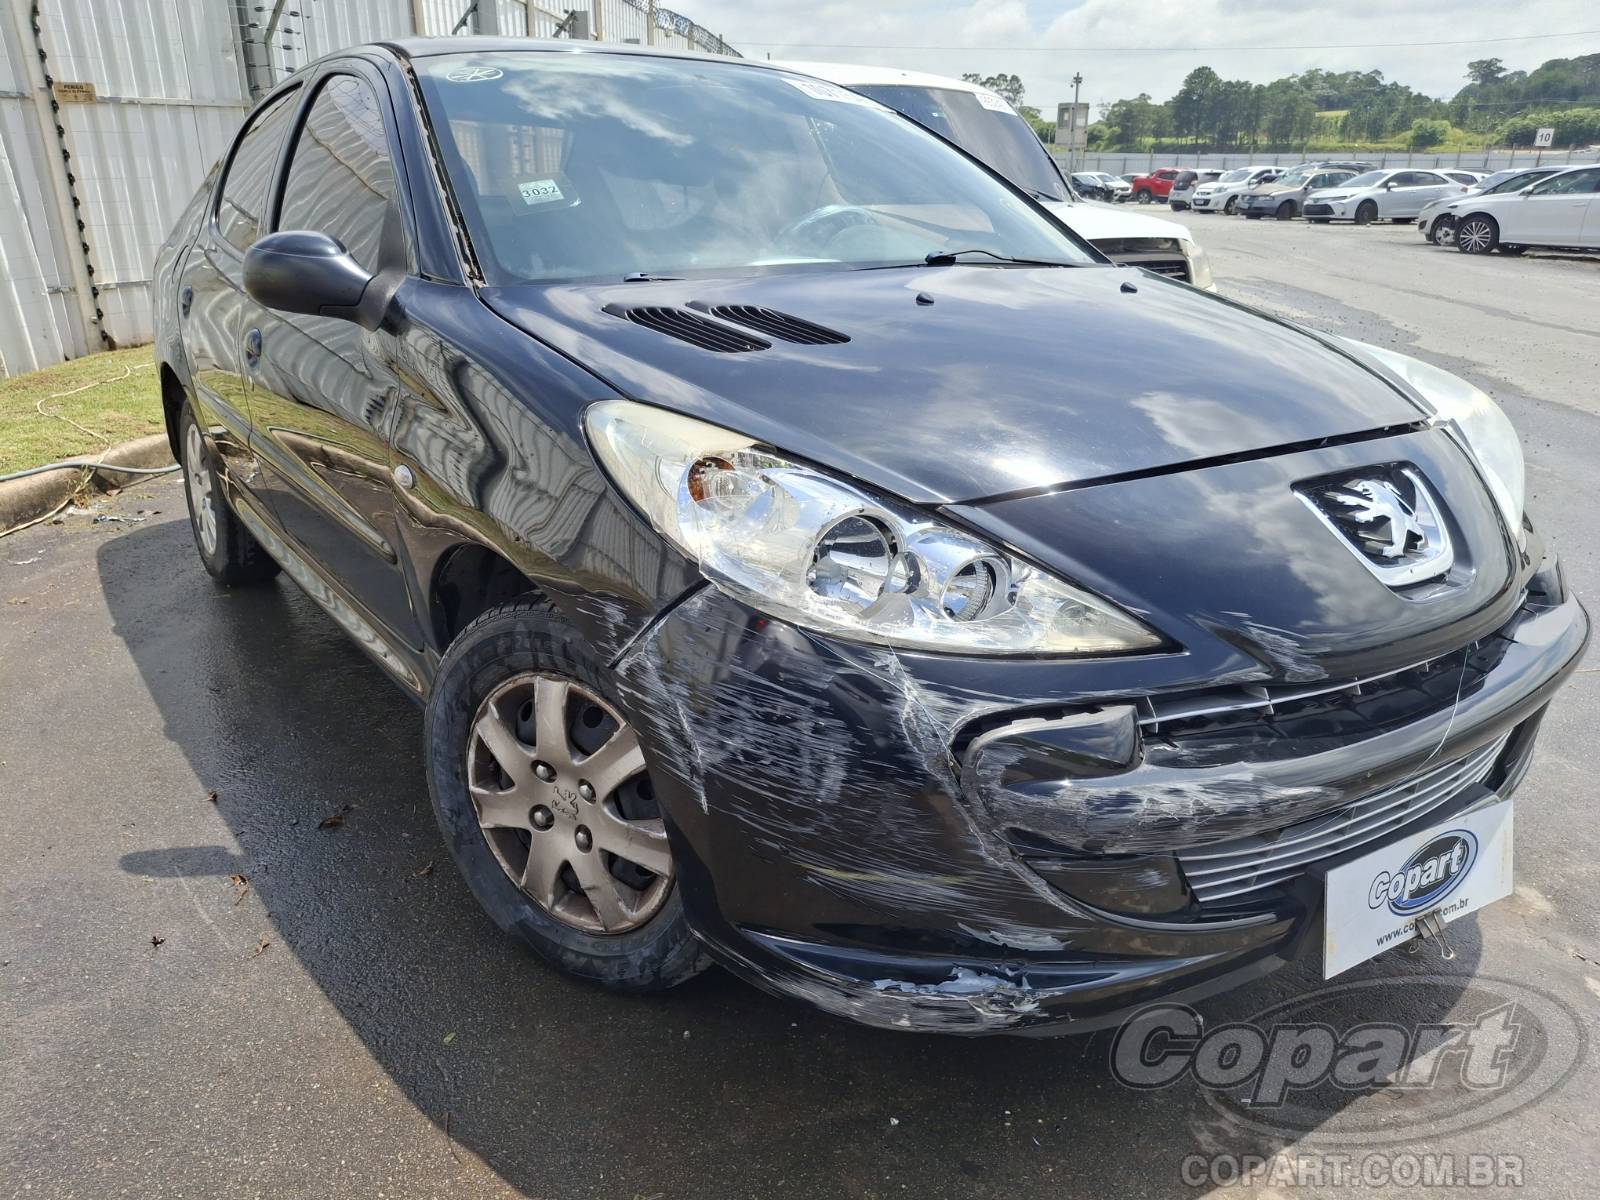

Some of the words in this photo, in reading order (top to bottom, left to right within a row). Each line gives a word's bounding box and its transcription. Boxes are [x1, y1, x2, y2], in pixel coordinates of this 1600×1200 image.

[1539, 133, 1551, 142] 10
[522, 186, 558, 198] 3032
[1368, 836, 1465, 910] Copart
